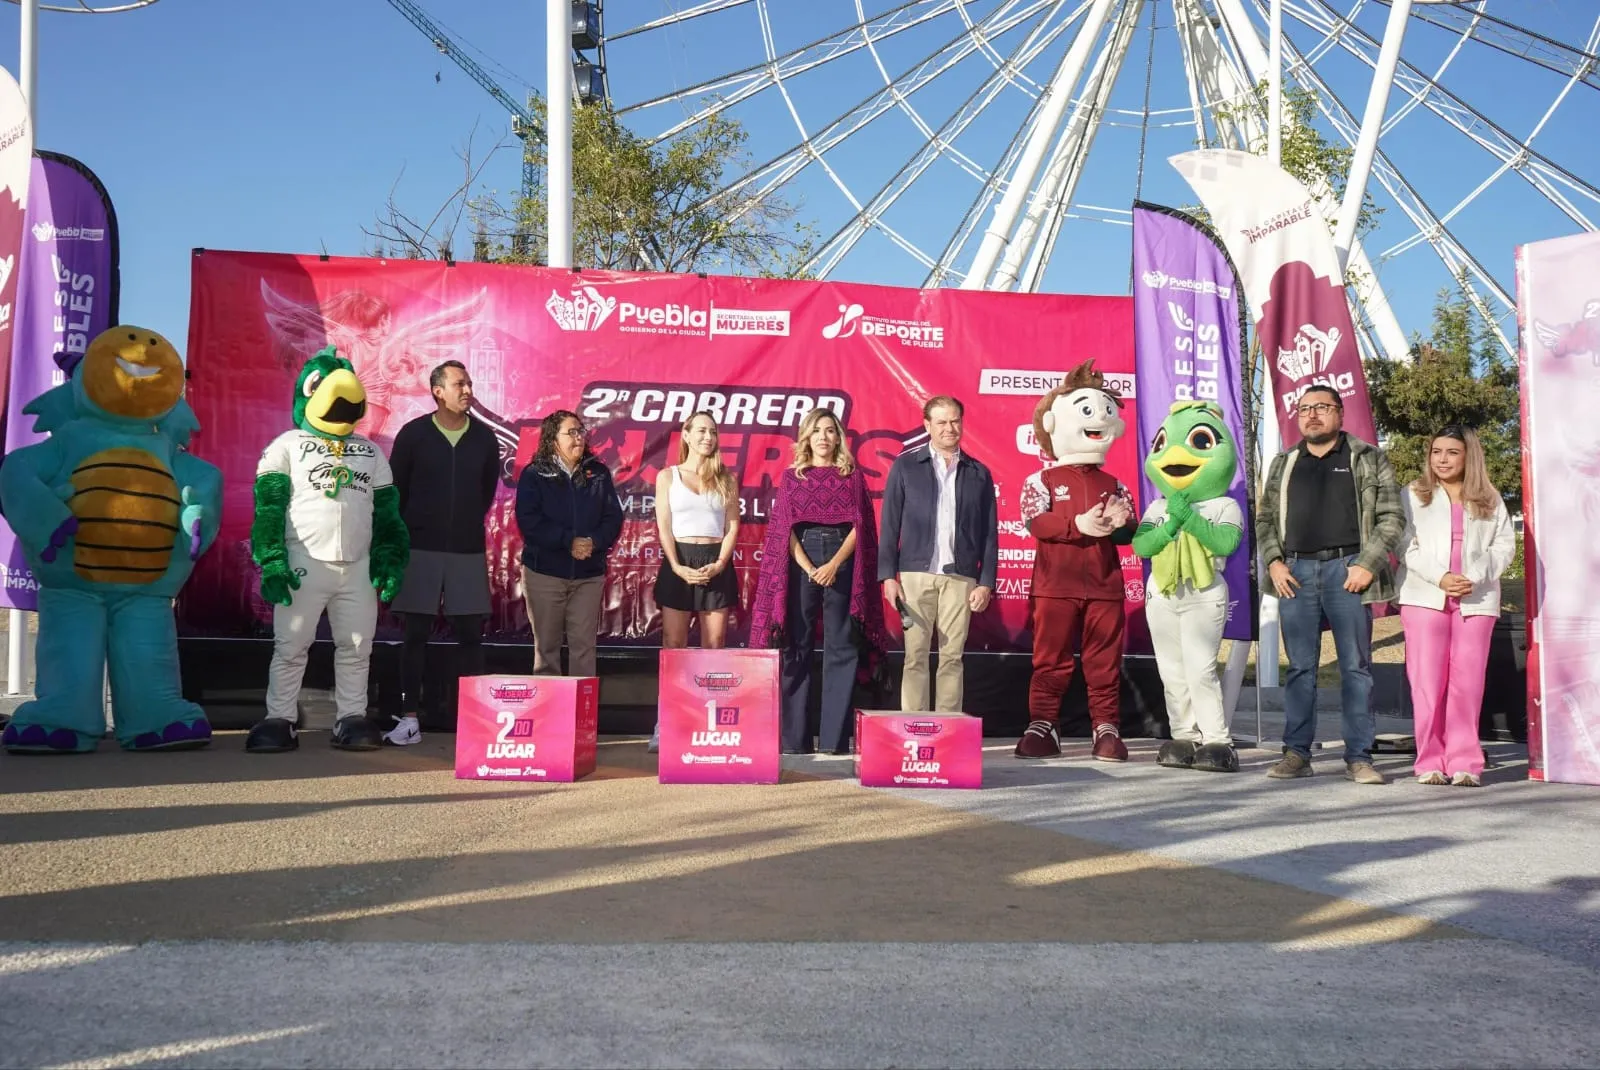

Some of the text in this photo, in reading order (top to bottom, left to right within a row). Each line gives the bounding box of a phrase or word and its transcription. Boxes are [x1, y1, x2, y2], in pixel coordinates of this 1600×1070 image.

[1249, 209, 1312, 244] IMPARABLE
[619, 302, 707, 327] Puebla
[716, 320, 784, 331] MUJERES
[889, 318, 920, 326] MUNICIPAL
[619, 325, 657, 334] GOBIERNO
[861, 321, 944, 341] DEPORTE
[913, 341, 944, 349] PUEBLA
[991, 375, 1062, 389] PRESENT
[631, 389, 845, 427] CARRERA
[691, 731, 742, 746] LUGAR
[486, 743, 536, 759] LUGAR
[901, 762, 941, 773] LUGAR
